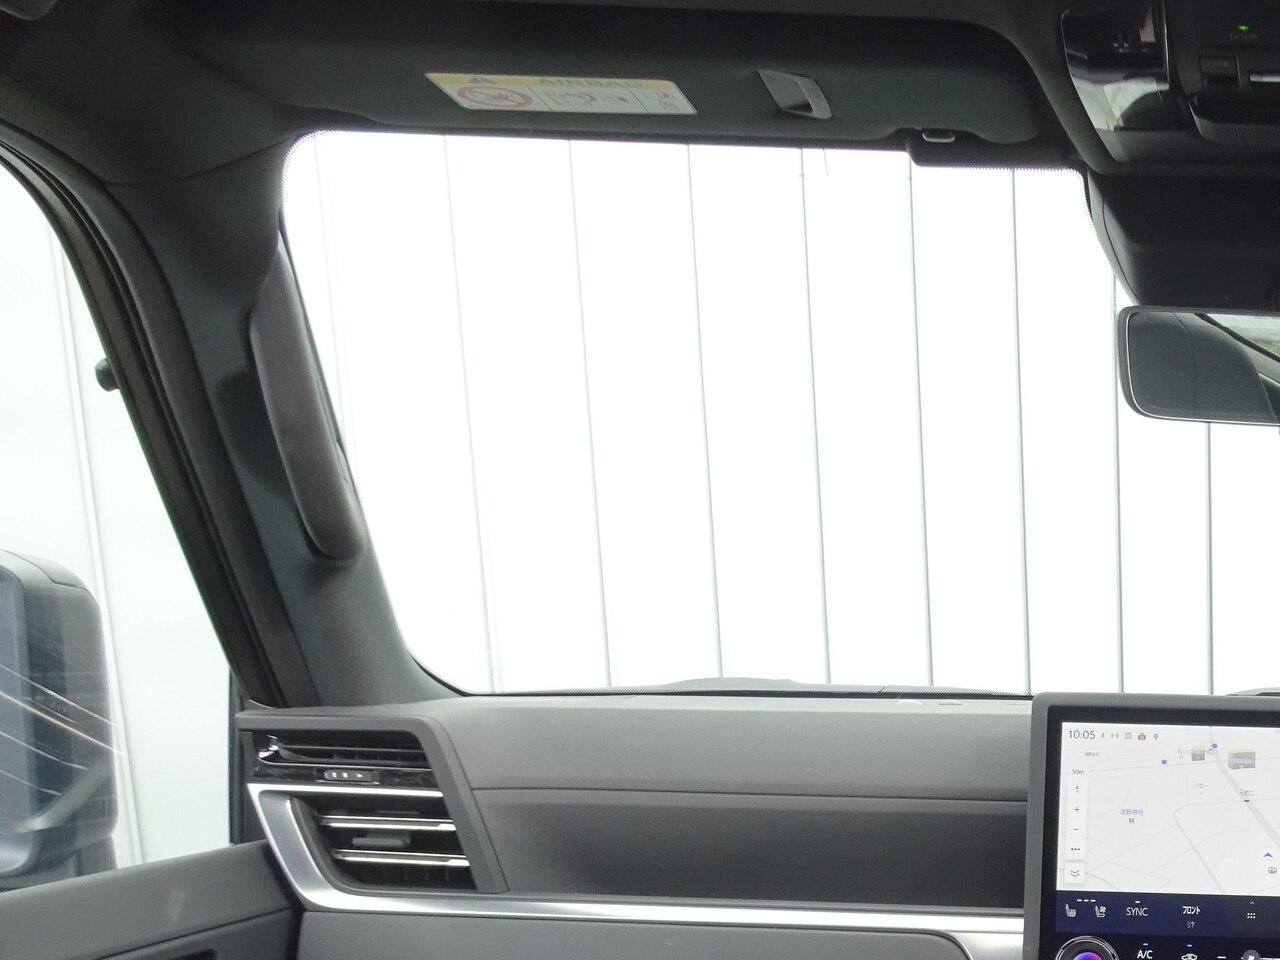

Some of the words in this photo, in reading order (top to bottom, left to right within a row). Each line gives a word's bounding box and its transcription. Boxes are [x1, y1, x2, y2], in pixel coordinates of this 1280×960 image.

[1068, 730, 1096, 739] 10:05
[1126, 907, 1149, 917] SYNC
[1182, 905, 1201, 915] フロント
[1136, 949, 1153, 959] A/C
